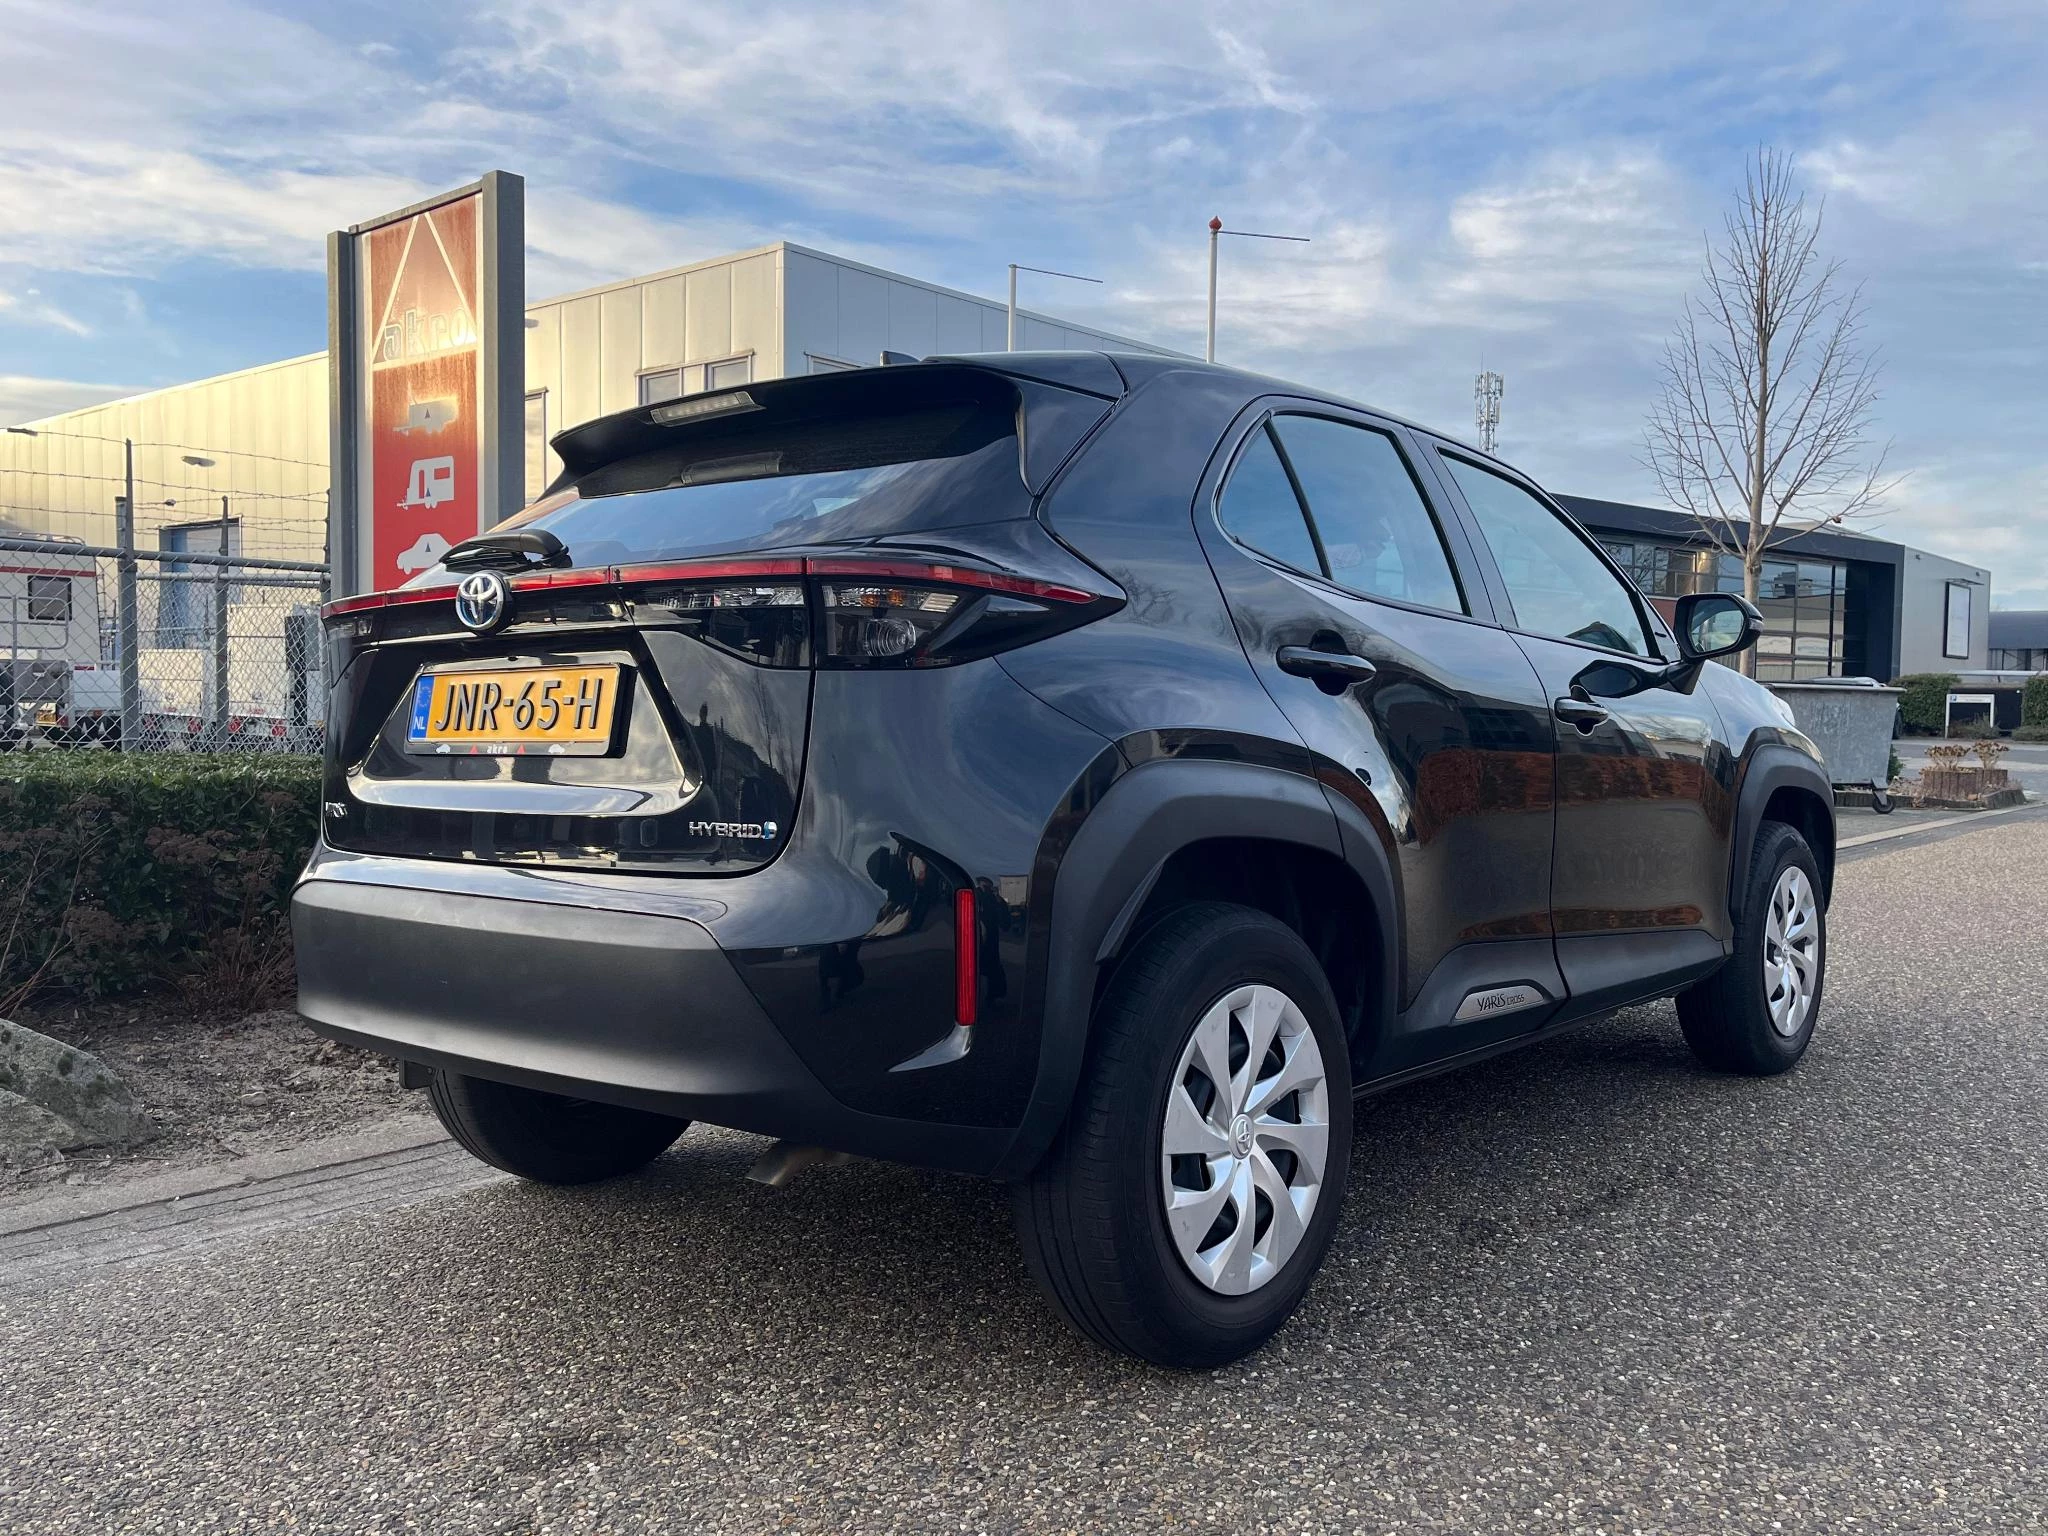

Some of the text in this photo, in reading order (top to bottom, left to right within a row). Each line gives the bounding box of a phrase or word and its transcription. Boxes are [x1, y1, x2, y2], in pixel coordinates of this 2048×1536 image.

[383, 307, 468, 361] akro
[413, 678, 604, 731] NL JNR-65-H
[689, 821, 762, 838] HYBRID
